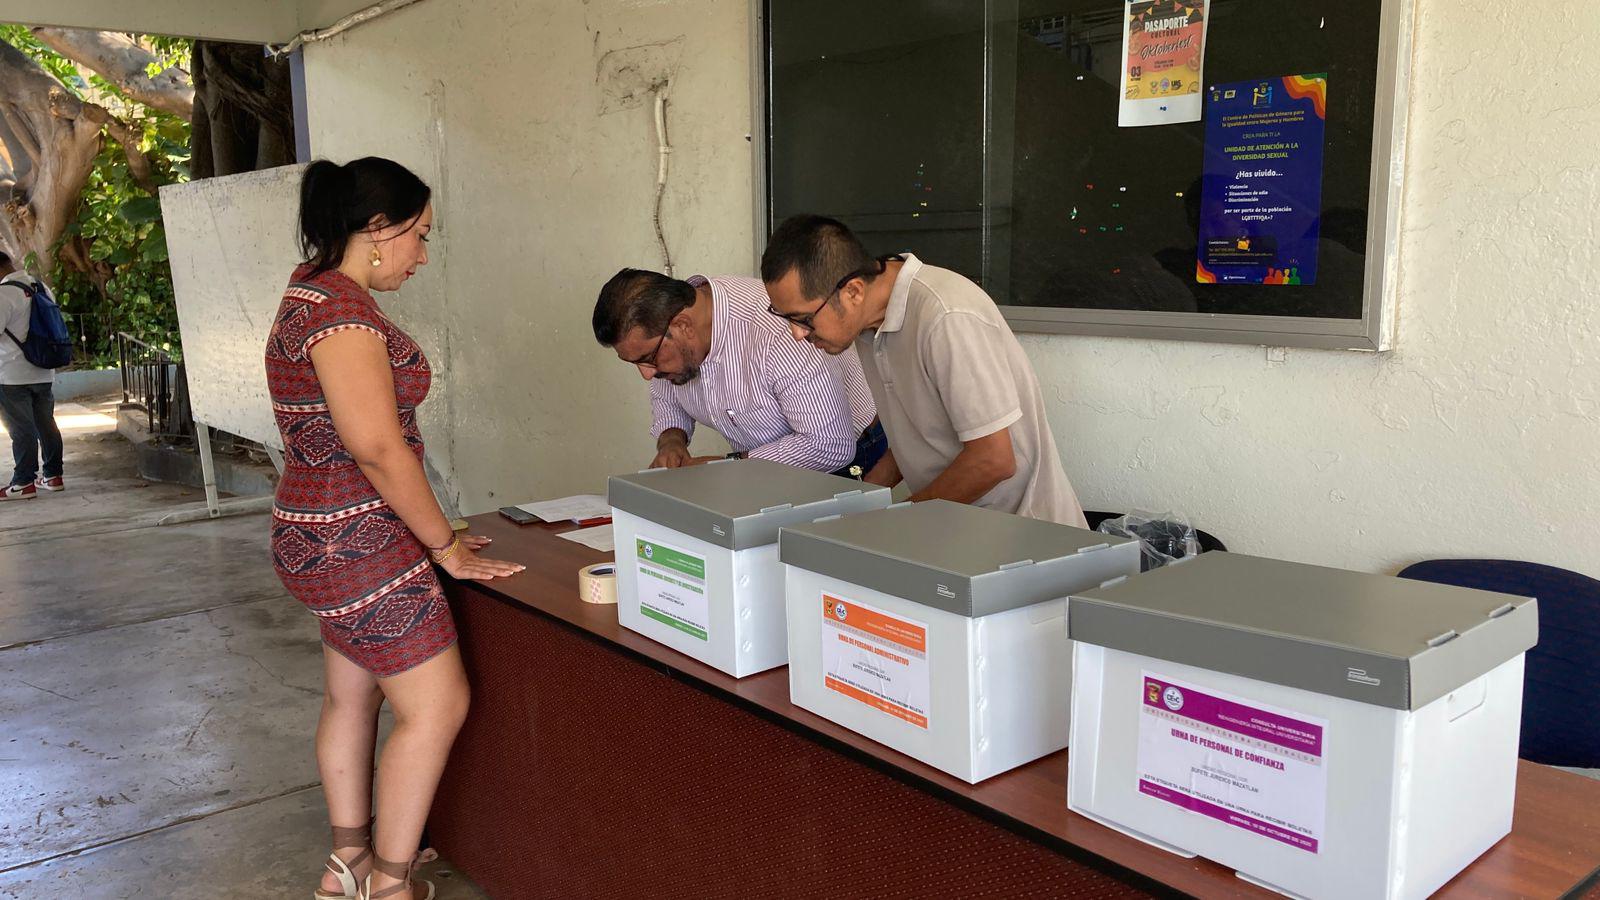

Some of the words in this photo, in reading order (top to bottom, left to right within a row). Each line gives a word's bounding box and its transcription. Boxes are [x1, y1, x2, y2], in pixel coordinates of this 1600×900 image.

[1144, 16, 1188, 32] PASAPORTE
[1151, 30, 1180, 38] CULTURAL
[1142, 34, 1192, 60] Oktoberfest
[1131, 66, 1141, 77] 03
[1227, 120, 1246, 128] Igualdad
[1255, 142, 1284, 151] ATENCIÓN
[1232, 152, 1265, 161] DIVERSIDAD
[1236, 170, 1253, 179] ¿Has
[1254, 169, 1283, 177] vivido...
[854, 639, 873, 653] PERSONAL
[874, 648, 909, 666] ADMINISTRATIVO
[1277, 725, 1316, 740] UNIVERSITARIA
[1171, 728, 1188, 741] URNA
[1190, 734, 1198, 744] DE
[1200, 738, 1233, 755] PERSONAL
[1235, 748, 1243, 758] DE
[1245, 751, 1284, 771] CONFIANZA
[1191, 766, 1208, 777] BUFETE
[1251, 810, 1264, 818] PARA
[1288, 823, 1312, 835] BOLETAS
[1267, 827, 1290, 840] OCTUBRE
